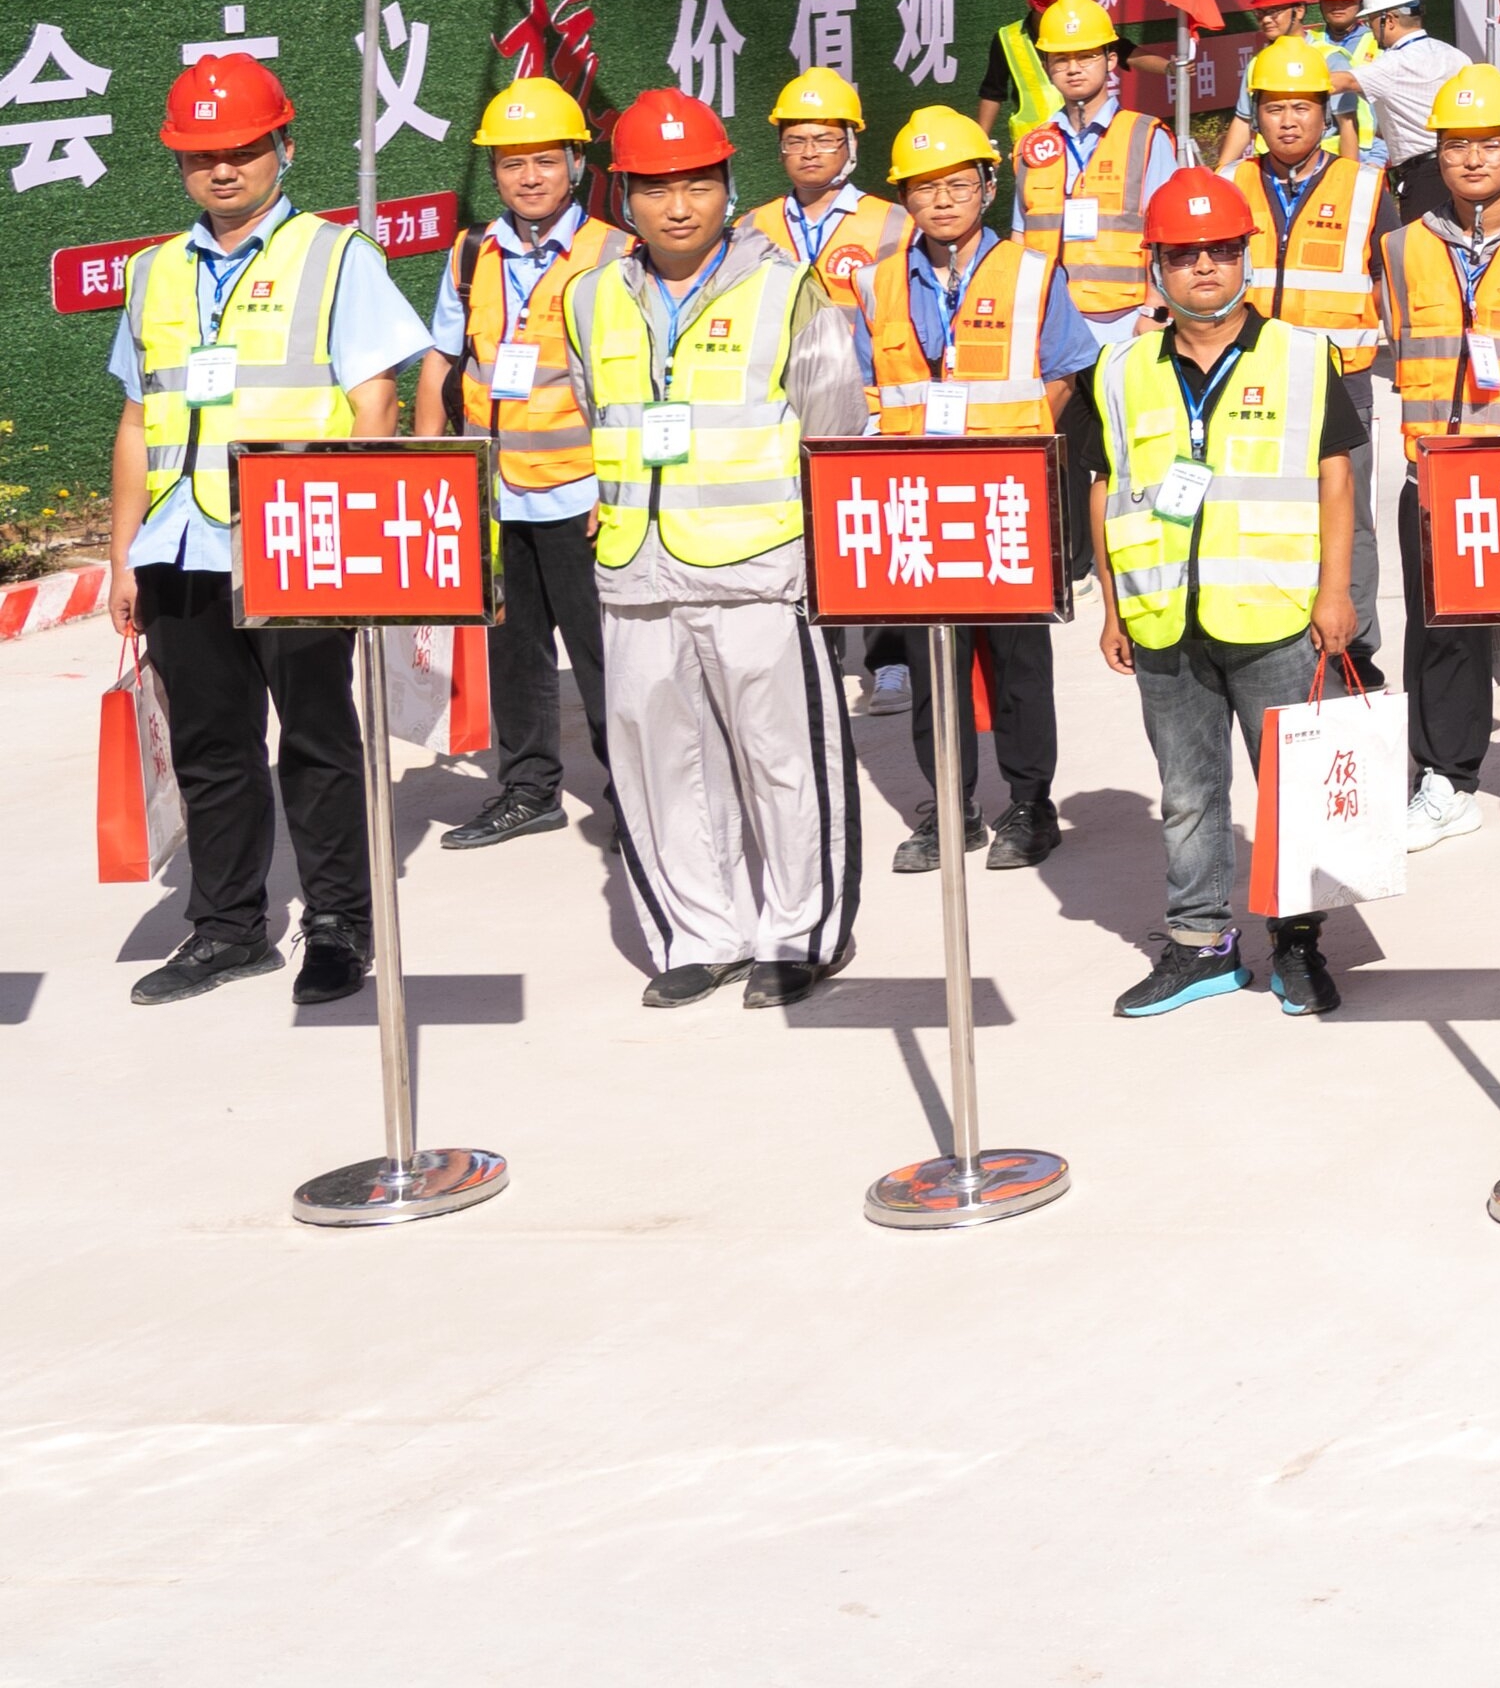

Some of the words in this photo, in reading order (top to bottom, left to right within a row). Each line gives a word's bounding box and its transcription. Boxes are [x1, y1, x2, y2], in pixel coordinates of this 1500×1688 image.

[0, 3, 451, 194] 会义
[1033, 134, 1057, 157] 62
[263, 478, 464, 591] 中国二十冶
[835, 474, 1035, 589] 中煤三建
